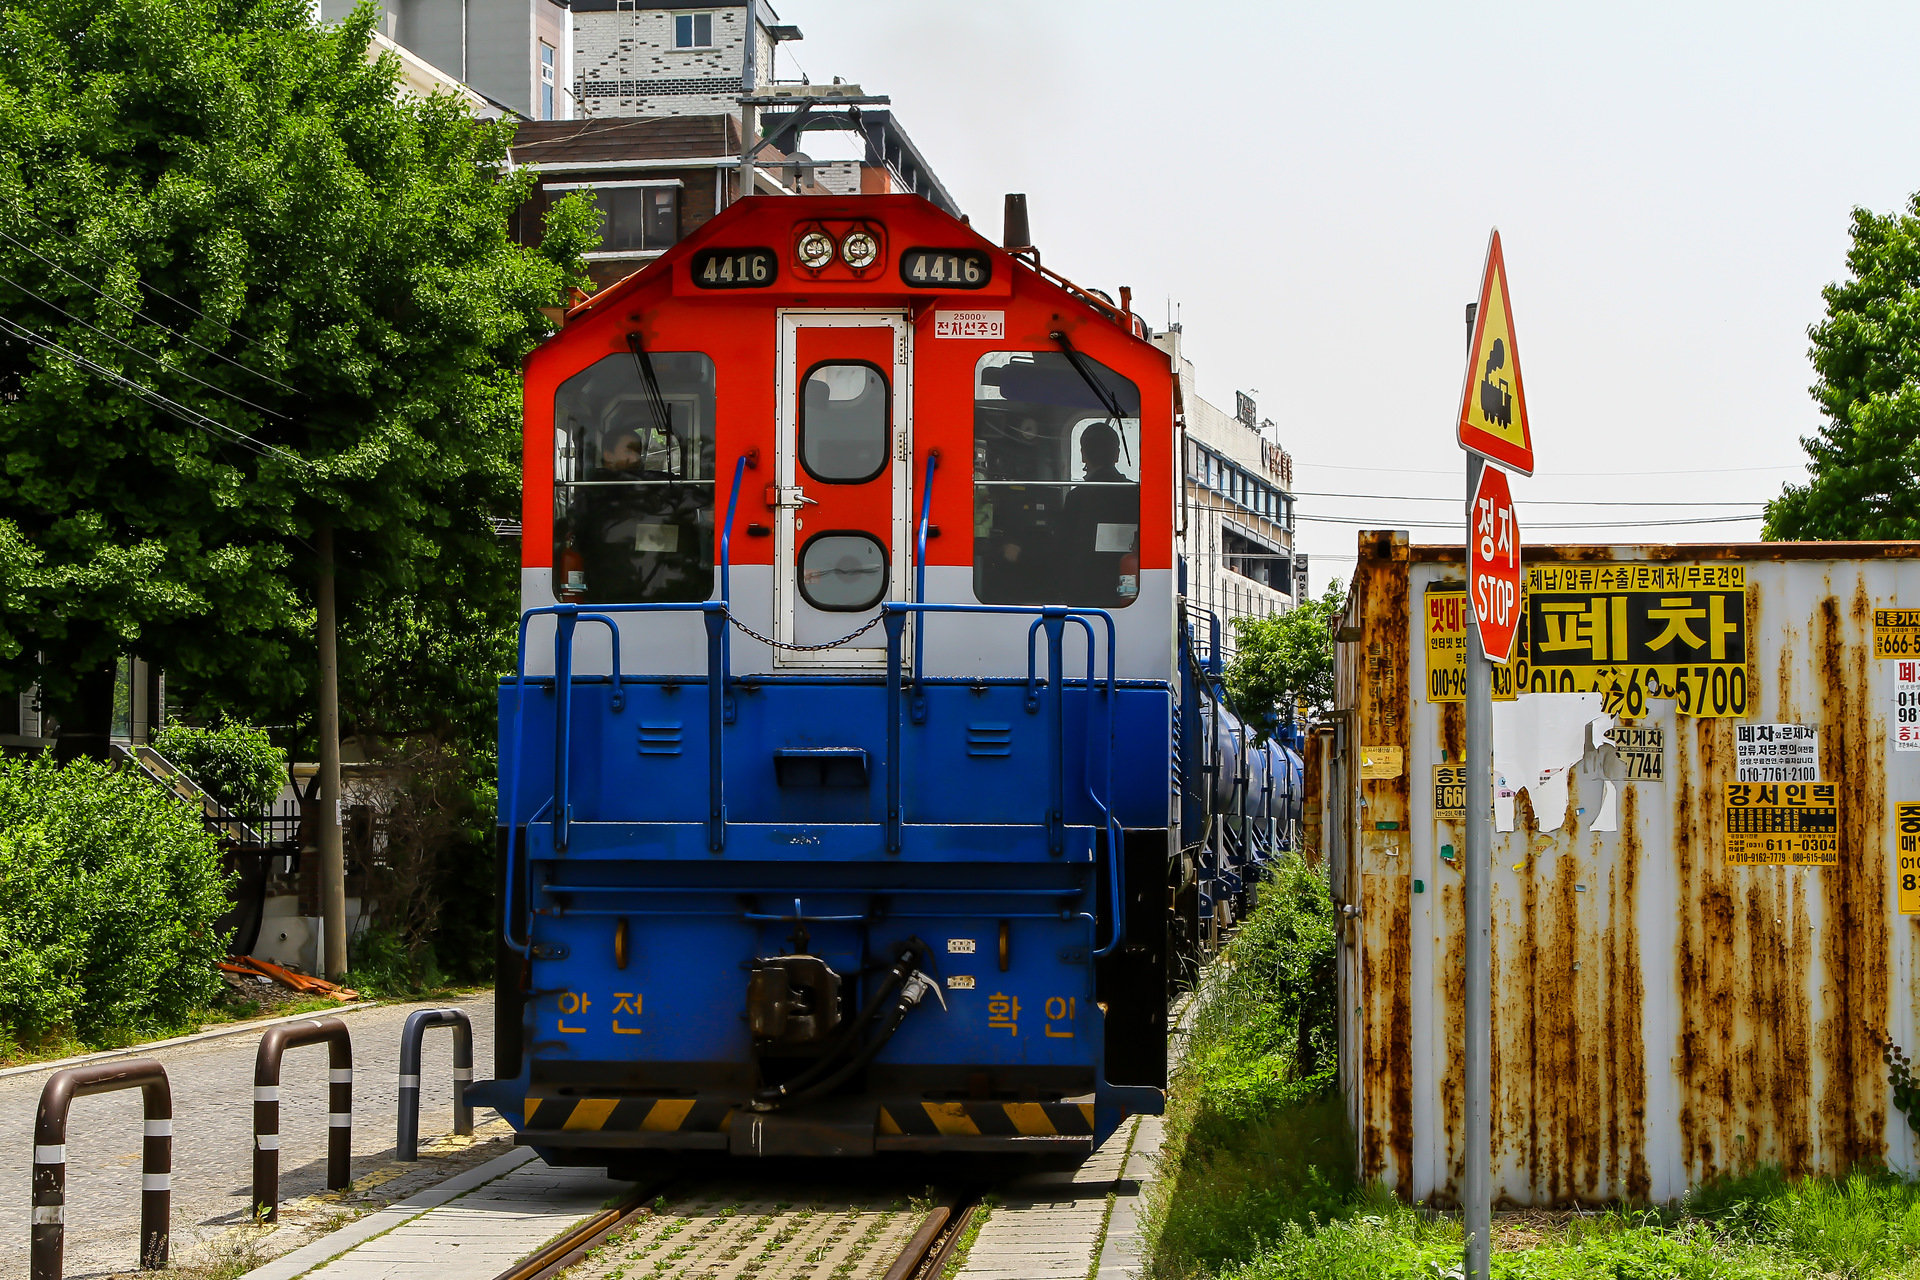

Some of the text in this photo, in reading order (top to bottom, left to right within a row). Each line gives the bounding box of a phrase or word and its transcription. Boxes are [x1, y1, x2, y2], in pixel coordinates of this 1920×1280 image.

[703, 255, 767, 283] 4416
[912, 255, 980, 283] 4416
[937, 321, 1003, 336] 전차선주의
[1478, 497, 1513, 569] 정지
[1529, 566, 1744, 590] 체납/압류/수출/문제차/무료견인
[1478, 573, 1514, 628] STOP
[1538, 595, 1737, 662] 폐차
[1899, 662, 1920, 683] 폐
[1740, 766, 1815, 782] 010-7761-2100
[1728, 784, 1835, 806] 강서인력
[1766, 839, 1836, 851] 611-0304
[558, 991, 1076, 1039] 안전 확인
